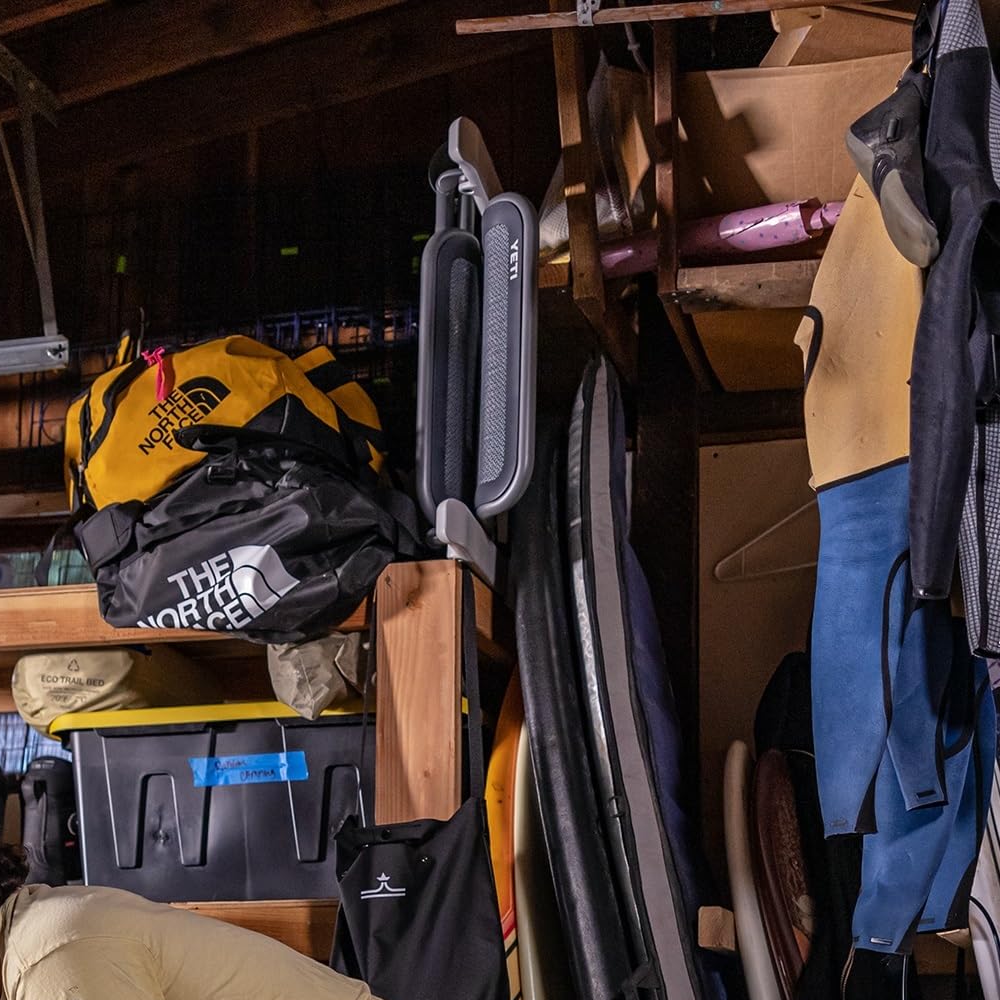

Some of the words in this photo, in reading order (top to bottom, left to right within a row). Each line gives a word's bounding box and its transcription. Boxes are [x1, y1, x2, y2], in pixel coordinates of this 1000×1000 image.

[510, 239, 519, 280] YETI
[148, 389, 182, 420] THE
[138, 398, 195, 456] NORTH
[162, 408, 204, 450] FCE
[167, 552, 231, 599] THE
[193, 599, 252, 629] CE
[41, 674, 58, 683] ECO
[61, 676, 84, 686] TRAIL
[86, 678, 105, 687] BED
